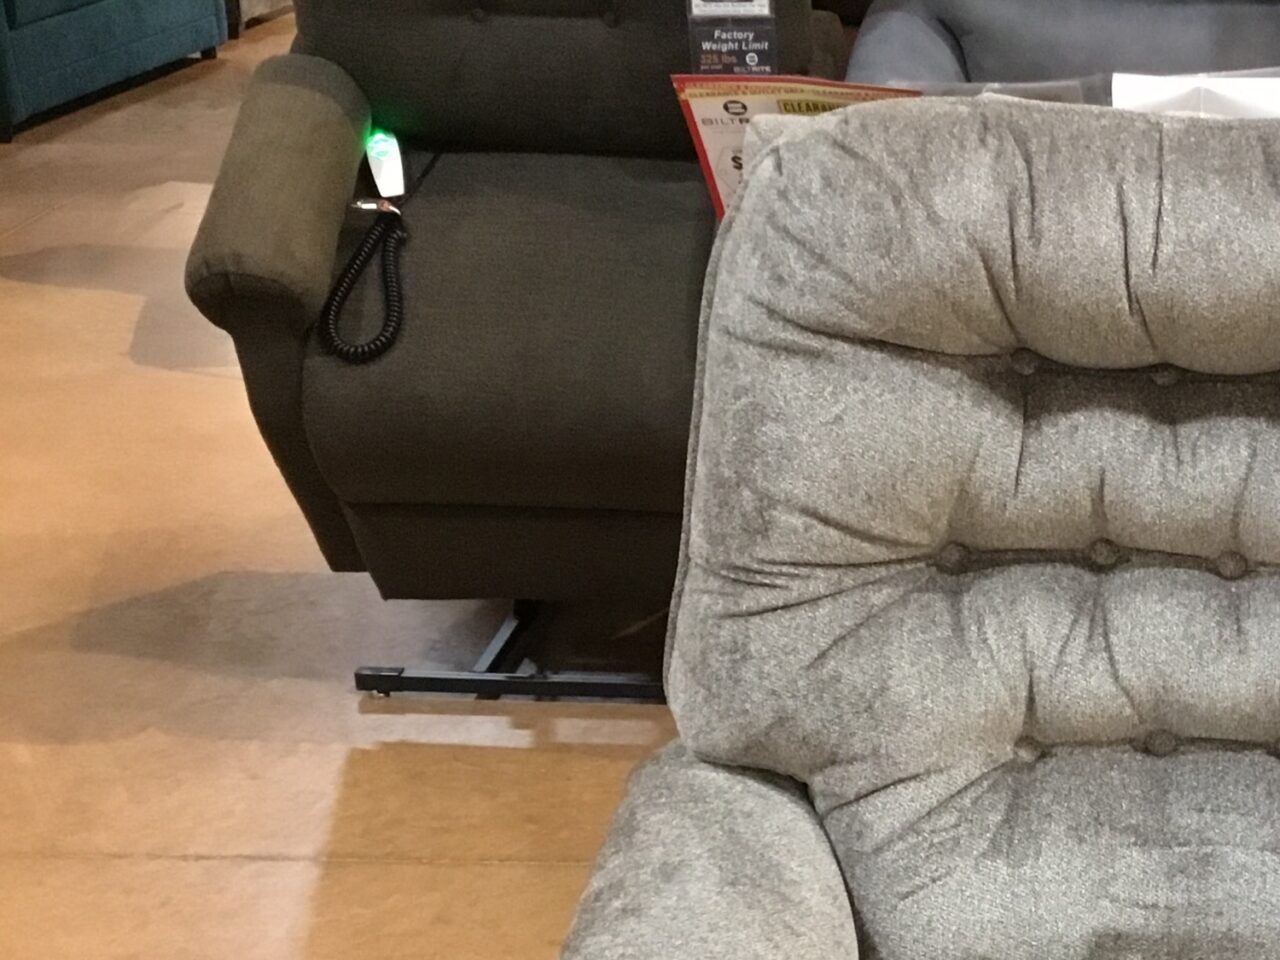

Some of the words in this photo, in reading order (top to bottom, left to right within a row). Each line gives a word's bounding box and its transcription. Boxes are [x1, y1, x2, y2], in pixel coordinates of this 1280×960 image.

[714, 30, 754, 41] Factory
[701, 41, 738, 52] Weight
[742, 41, 769, 50] Limit
